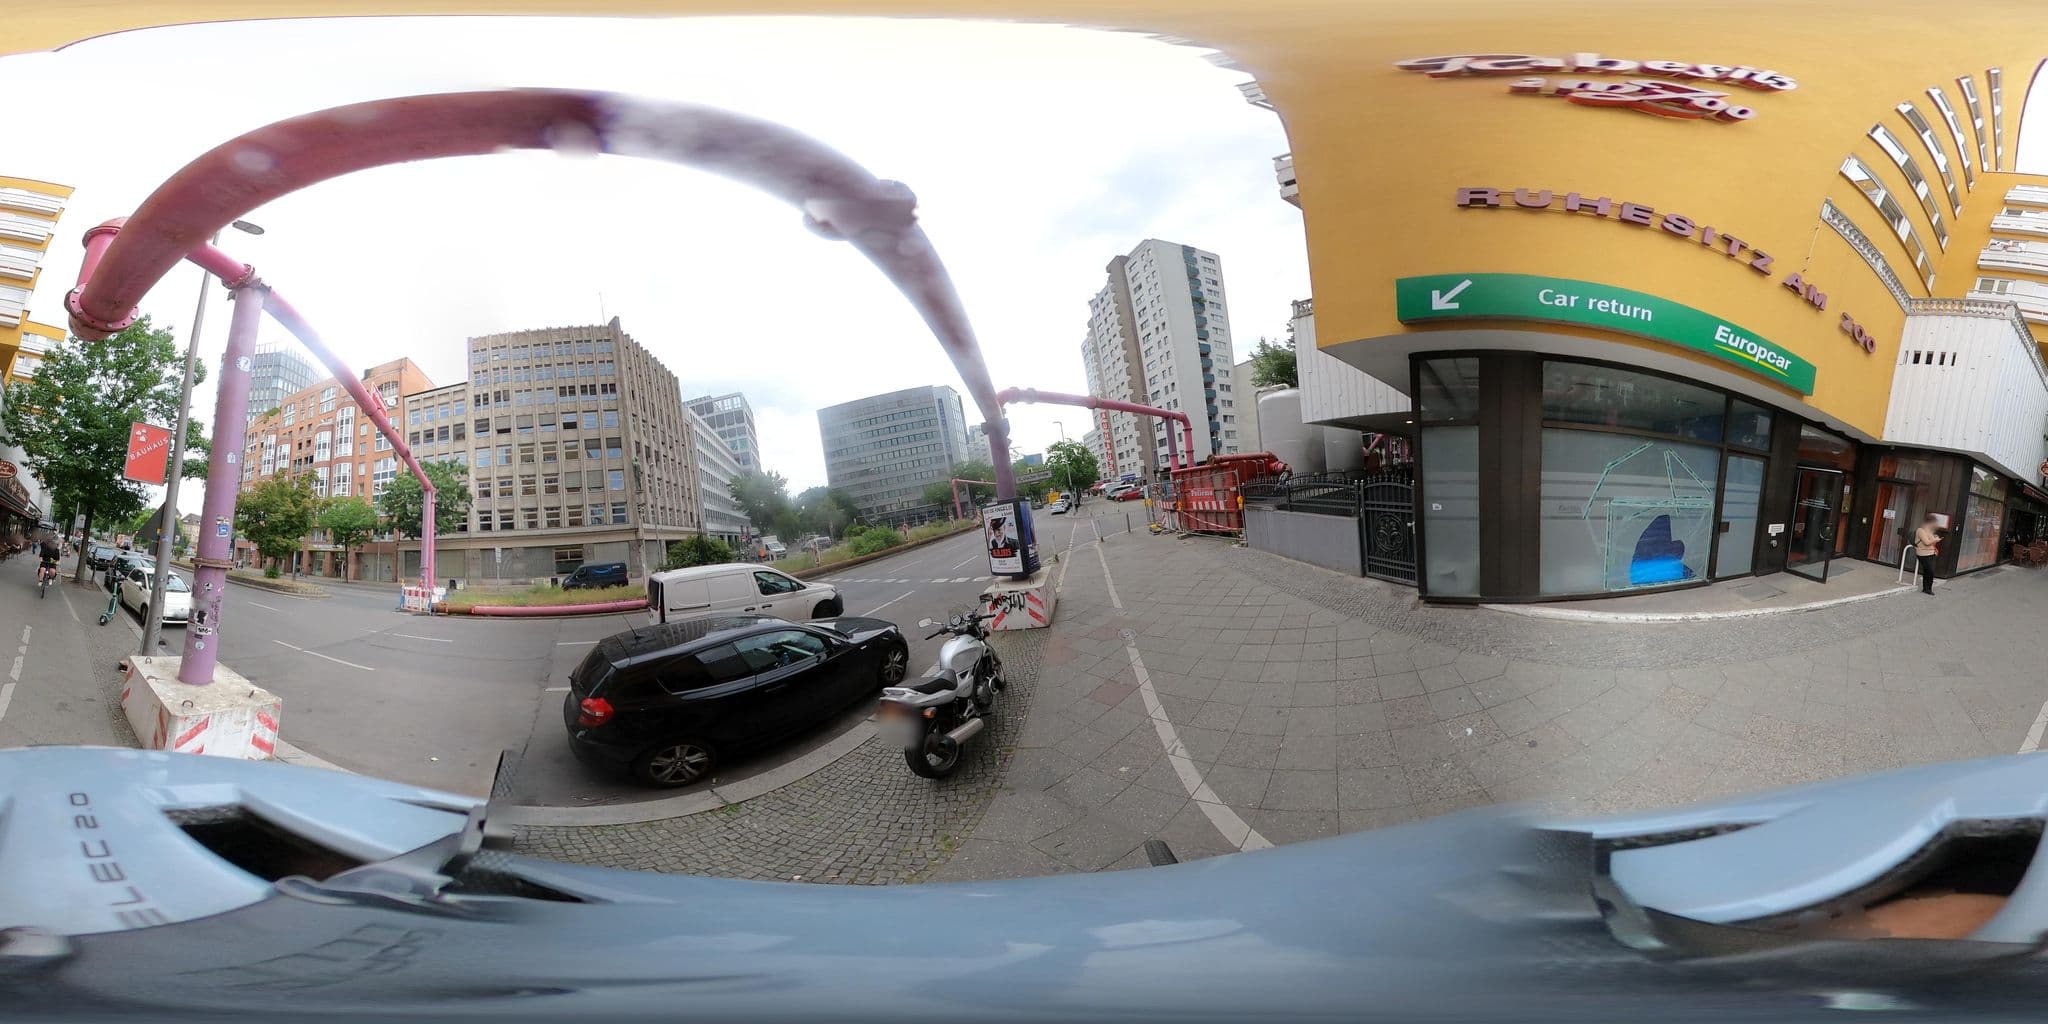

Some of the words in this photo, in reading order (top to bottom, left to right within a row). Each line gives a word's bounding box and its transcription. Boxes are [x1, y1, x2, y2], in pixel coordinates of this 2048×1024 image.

[1567, 79, 1756, 120] Zoo
[1457, 187, 1774, 276] RUHESITZ
[1782, 272, 1827, 311] AM
[1841, 312, 1876, 353] ZOO
[1538, 289, 1579, 307] Car
[1588, 297, 1652, 321] return
[1714, 325, 1792, 370] Europcar
[130, 436, 169, 461] BAUHAUS
[69, 792, 99, 829] 2.0
